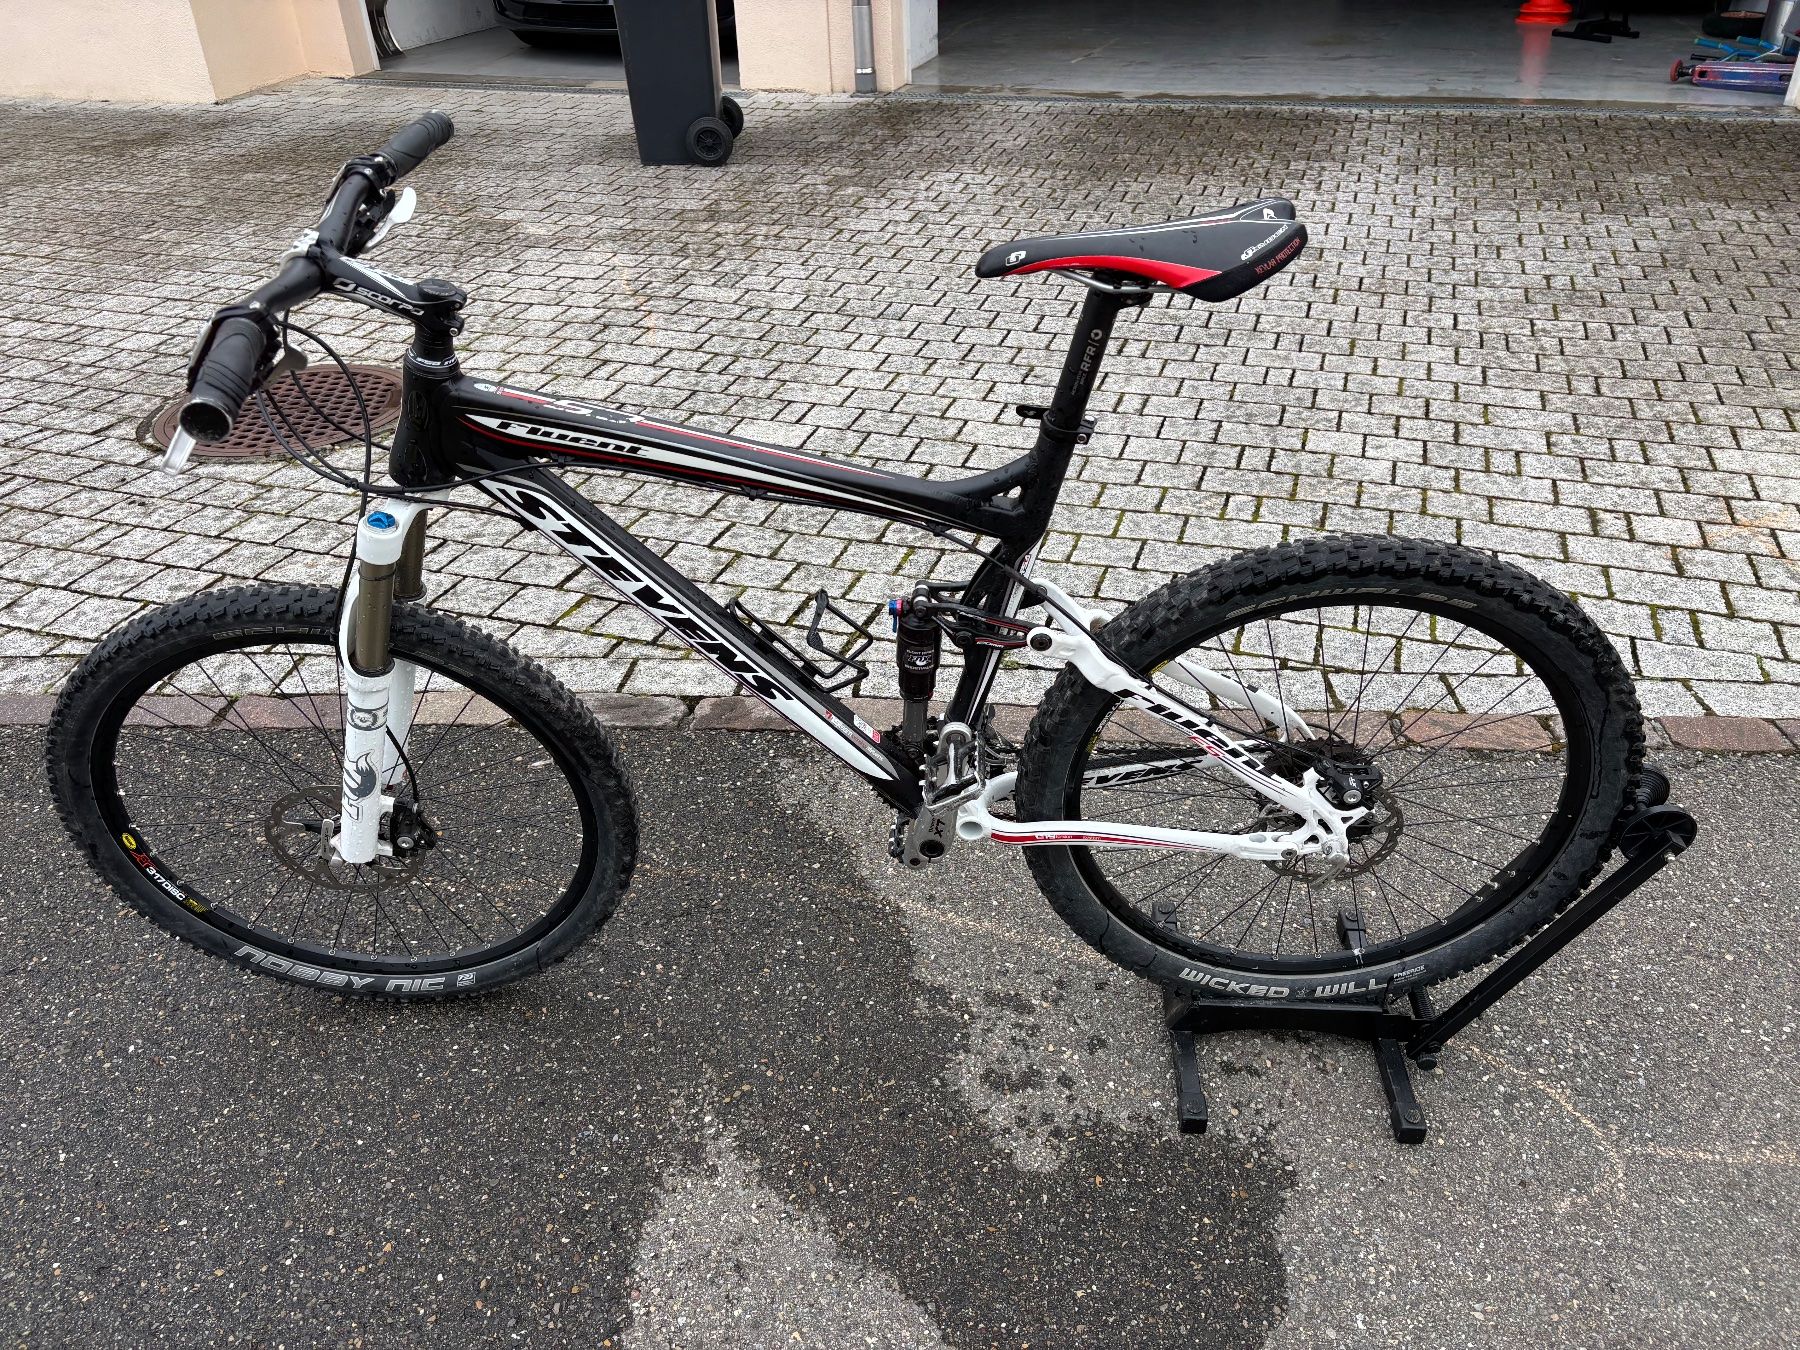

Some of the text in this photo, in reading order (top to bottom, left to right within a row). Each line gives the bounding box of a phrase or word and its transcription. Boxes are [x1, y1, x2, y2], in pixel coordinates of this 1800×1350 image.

[1254, 258, 1277, 275] KEVLAR
[1275, 236, 1301, 264] PROTECTION
[1080, 345, 1097, 372] RFR
[495, 487, 796, 701] STEVENS
[233, 945, 447, 993] NOBBY NIC
[1179, 967, 1388, 999] WICKED WILL
